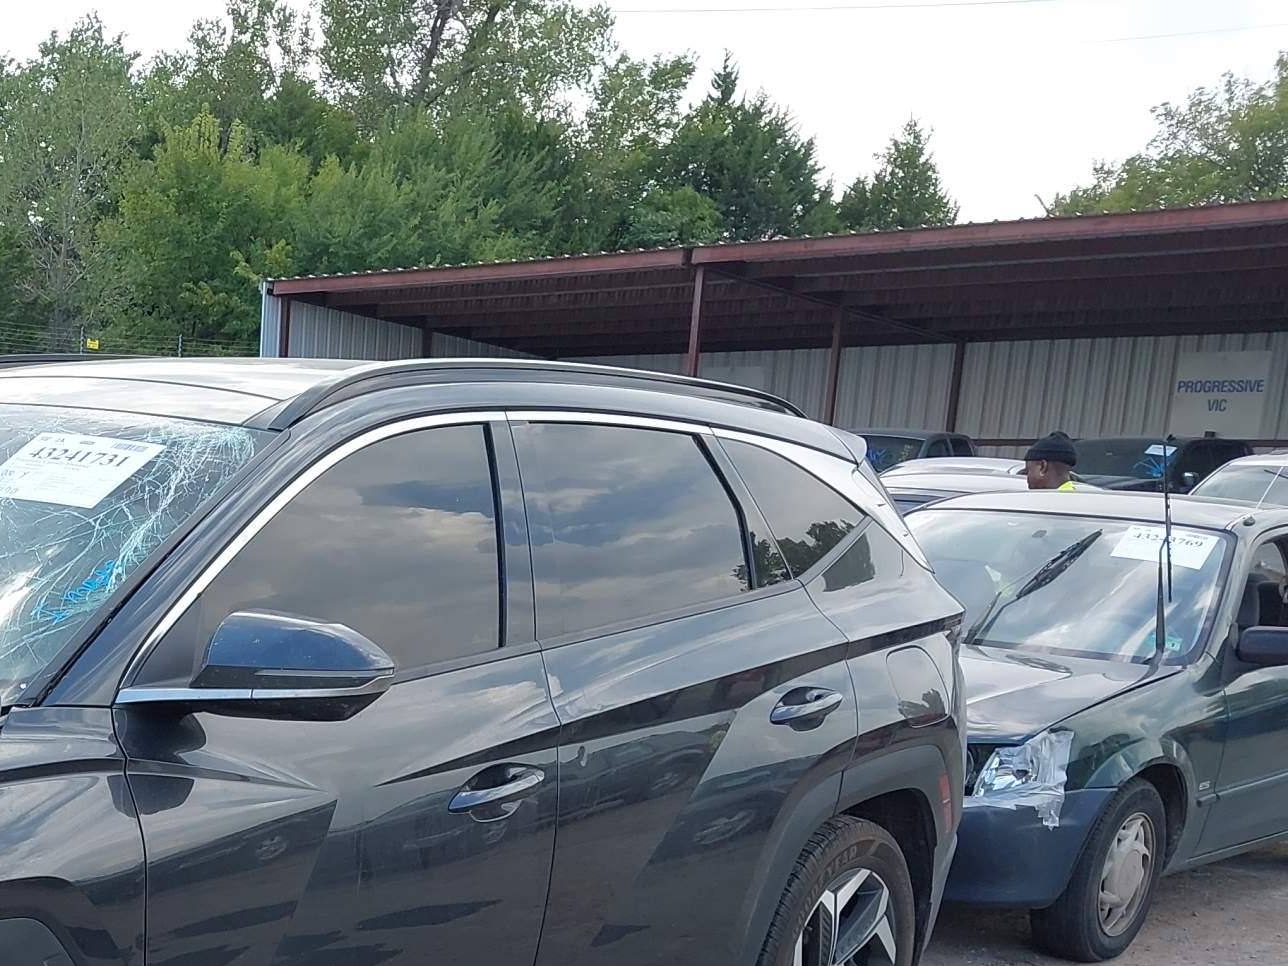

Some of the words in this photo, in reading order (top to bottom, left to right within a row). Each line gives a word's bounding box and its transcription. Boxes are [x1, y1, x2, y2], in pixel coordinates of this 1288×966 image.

[1177, 380, 1265, 393] PROGRESSIVE
[1207, 399, 1228, 412] VIC
[29, 446, 131, 467] 43241731
